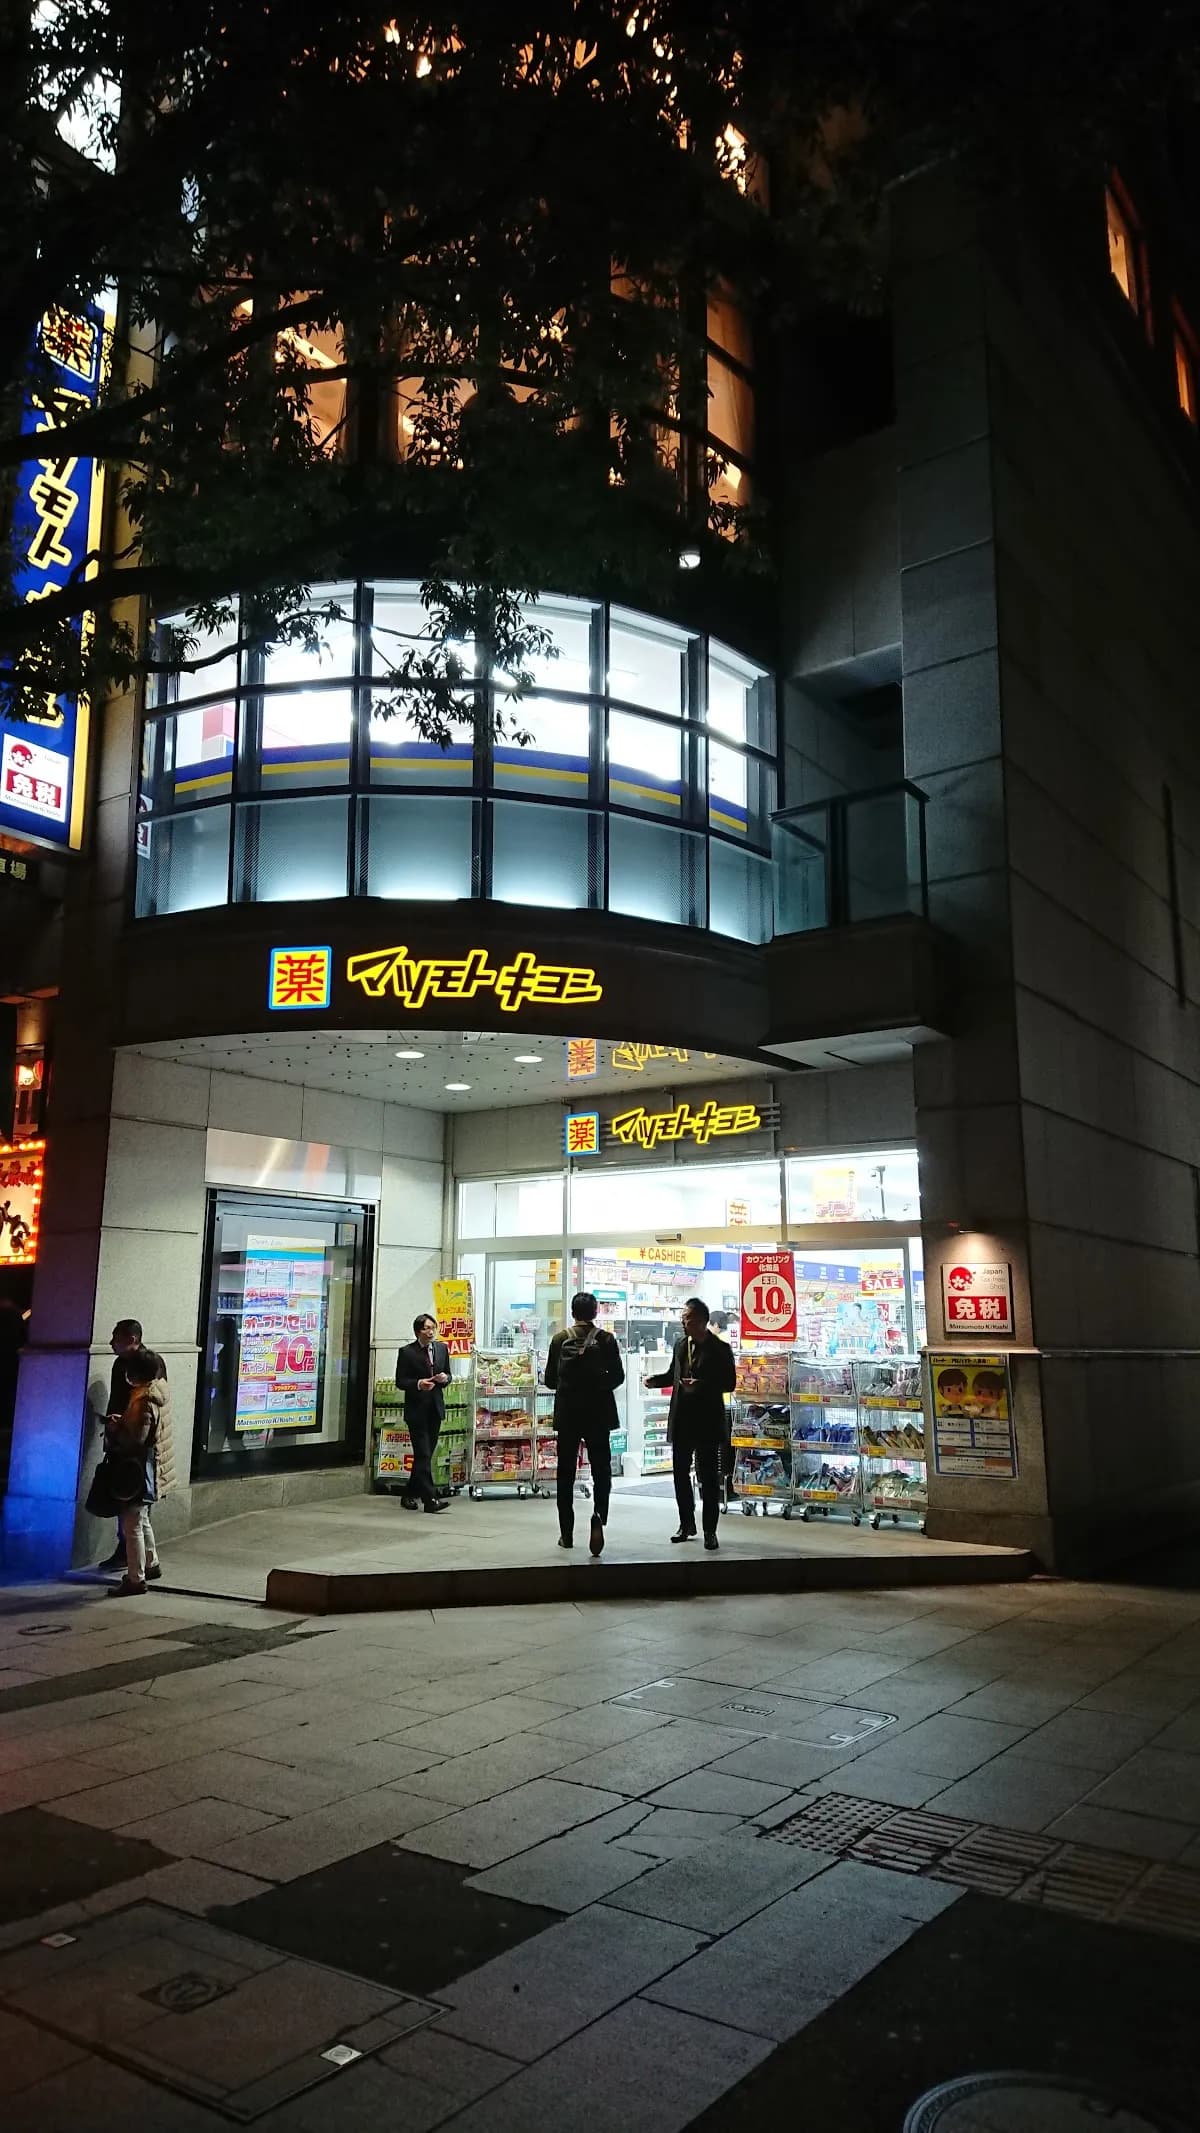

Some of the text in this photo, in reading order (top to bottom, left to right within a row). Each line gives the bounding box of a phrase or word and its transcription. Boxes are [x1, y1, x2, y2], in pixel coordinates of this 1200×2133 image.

[11, 773, 58, 807] 免税
[273, 946, 602, 1011] 薬 マツモトキヨシ
[567, 1101, 760, 1152] 薬 マツモトキヨシ
[648, 1247, 687, 1263] CASHIER
[746, 1255, 790, 1264] カウンセリング
[865, 1279, 899, 1290] SALE
[955, 1298, 1001, 1319] 免税
[448, 1340, 474, 1354] ALE
